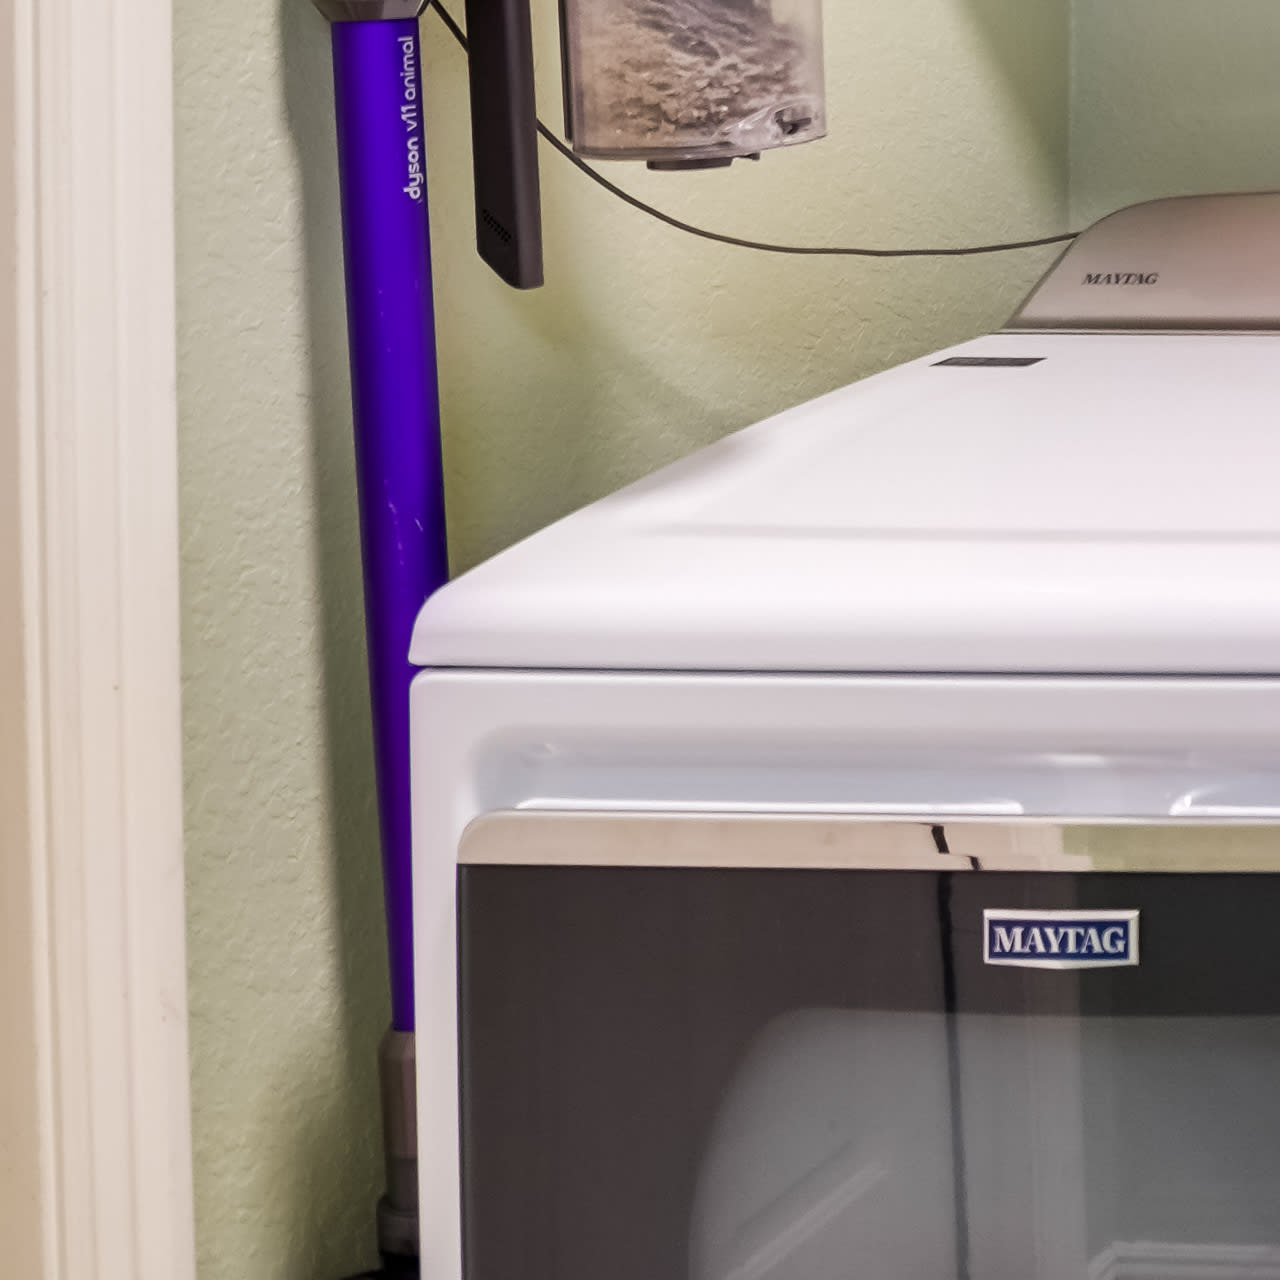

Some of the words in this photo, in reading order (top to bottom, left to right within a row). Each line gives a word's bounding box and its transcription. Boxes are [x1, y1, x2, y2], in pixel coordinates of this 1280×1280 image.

[397, 35, 417, 101] animal
[400, 104, 418, 132] v11
[403, 136, 425, 200] dyson
[1081, 273, 1160, 286] MAYTAG
[994, 926, 1126, 954] MAYTAG
